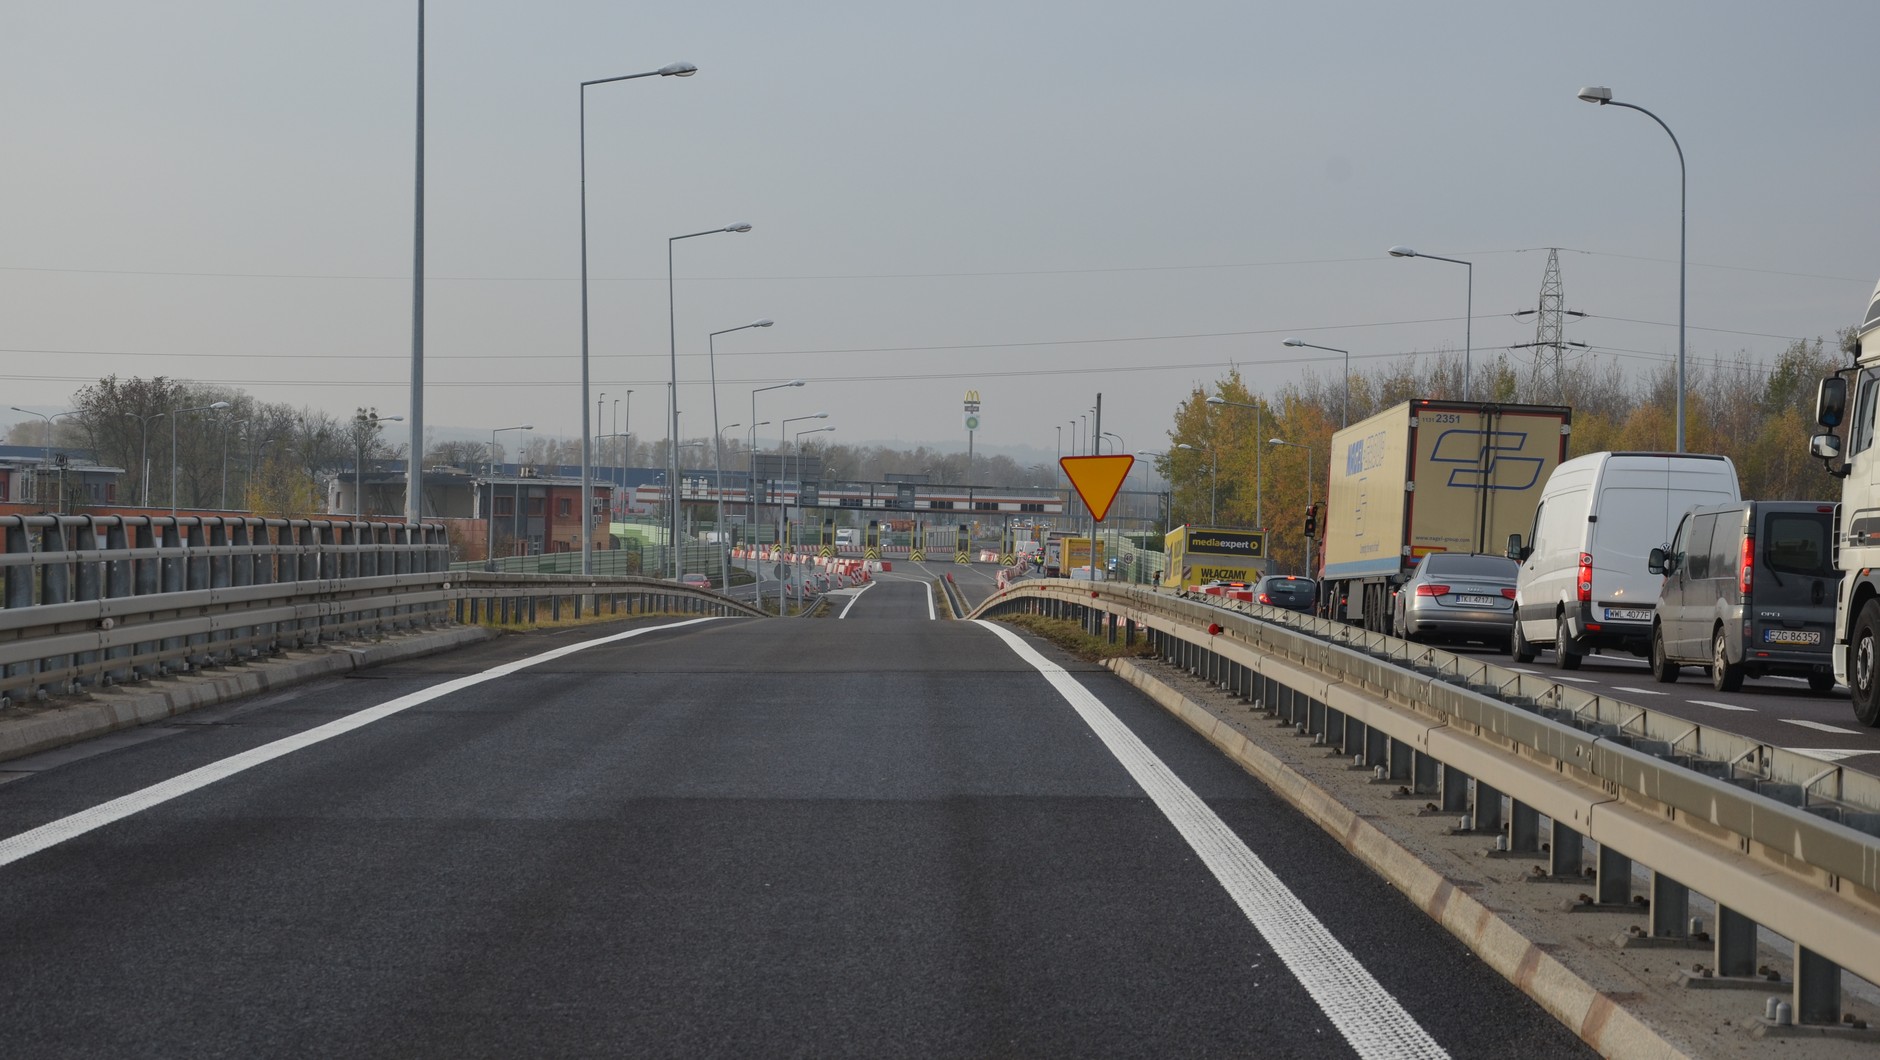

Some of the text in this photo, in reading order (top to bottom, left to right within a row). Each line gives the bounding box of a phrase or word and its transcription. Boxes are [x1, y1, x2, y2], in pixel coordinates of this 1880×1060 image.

[1436, 413, 1460, 424] 2351
[1192, 538, 1249, 549] mediaexpert
[1610, 610, 1650, 619] WWL 4077F
[1770, 630, 1819, 643] EZG 86352
